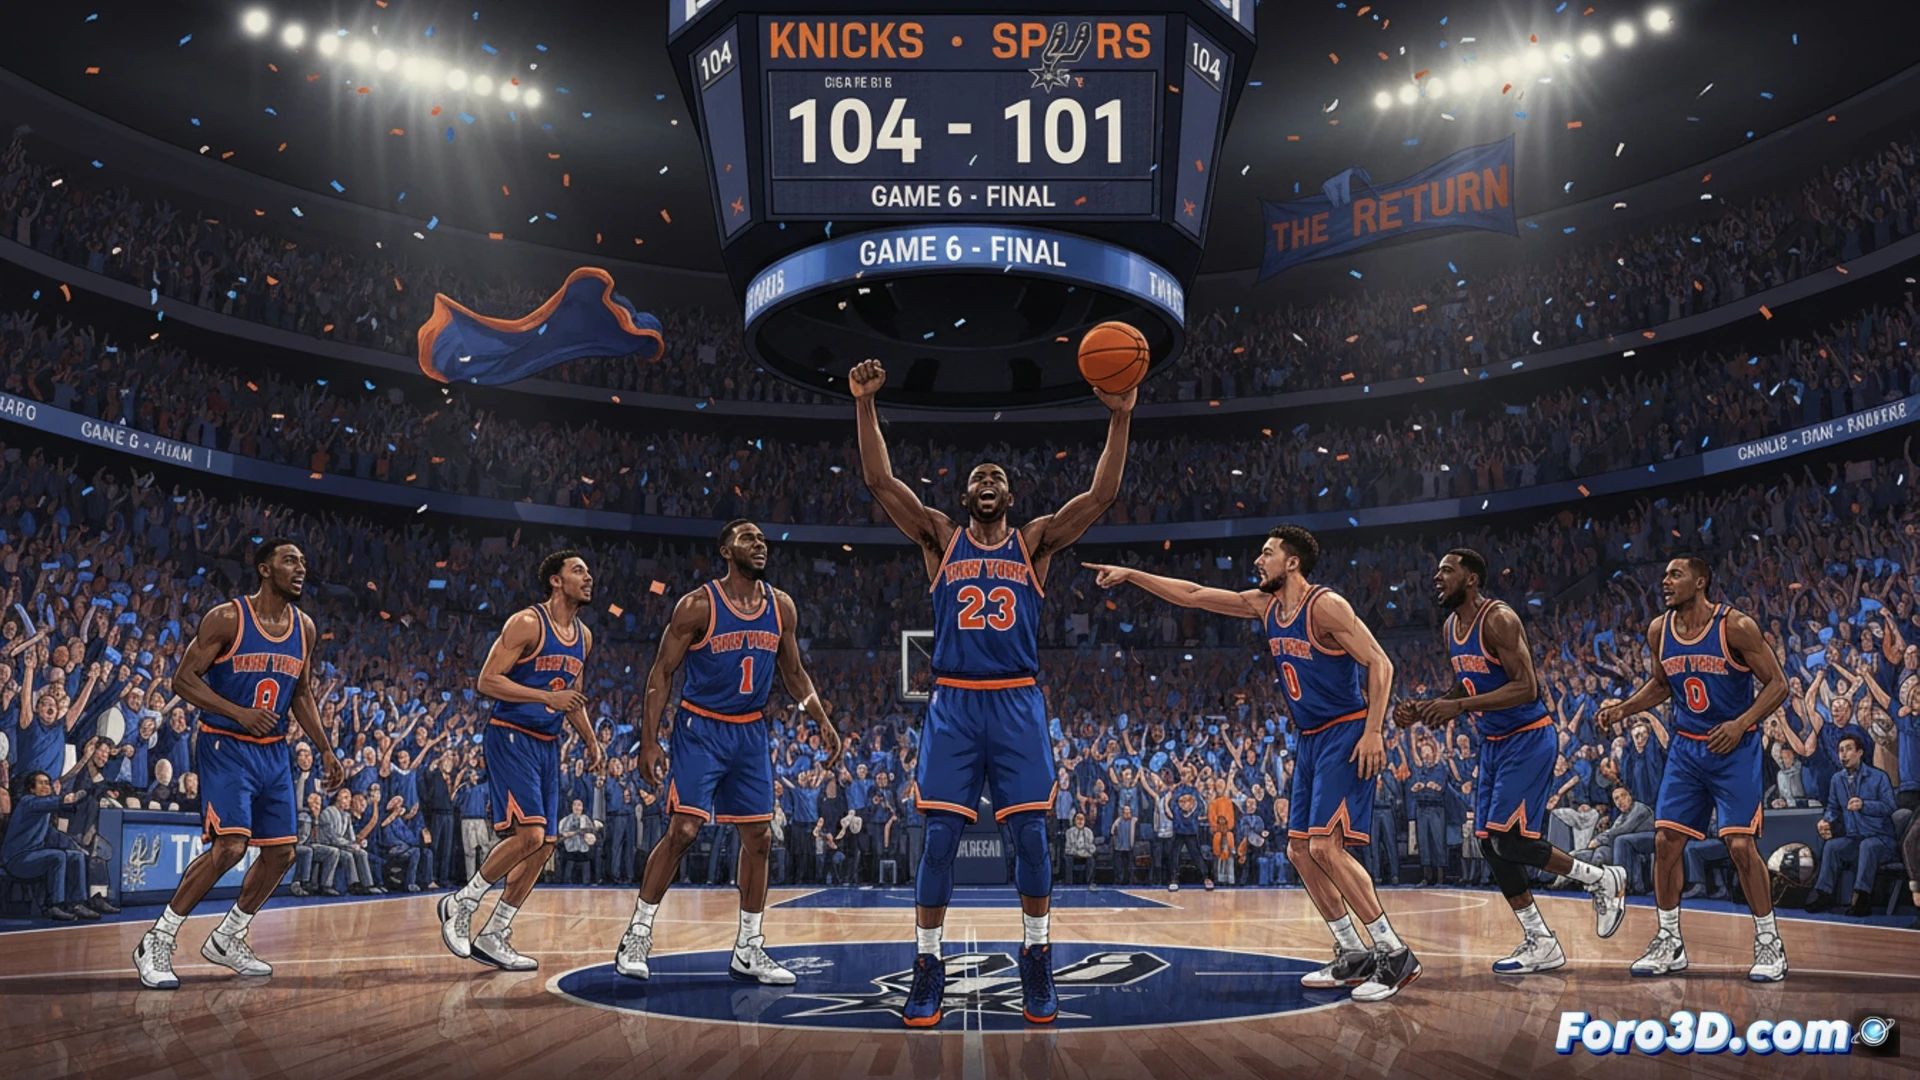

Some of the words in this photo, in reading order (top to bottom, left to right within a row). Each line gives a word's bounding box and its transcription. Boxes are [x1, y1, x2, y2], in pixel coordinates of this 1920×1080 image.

[770, 22, 924, 59] KNICKS
[701, 40, 732, 81] 104
[1193, 42, 1220, 81] 104
[789, 97, 922, 164] 104
[1004, 97, 1122, 164] 101
[871, 185, 941, 208] GAME
[947, 185, 962, 208] 6
[986, 185, 1056, 208] FINAL
[1272, 211, 1330, 252] THE
[1352, 164, 1509, 238] RETURN
[859, 236, 937, 266] GAME
[945, 236, 963, 262] 6
[990, 236, 1067, 268] FINAL
[957, 585, 1017, 631] 23
[739, 656, 754, 694] 1
[1281, 661, 1302, 701] 0
[1683, 677, 1710, 714] 0
